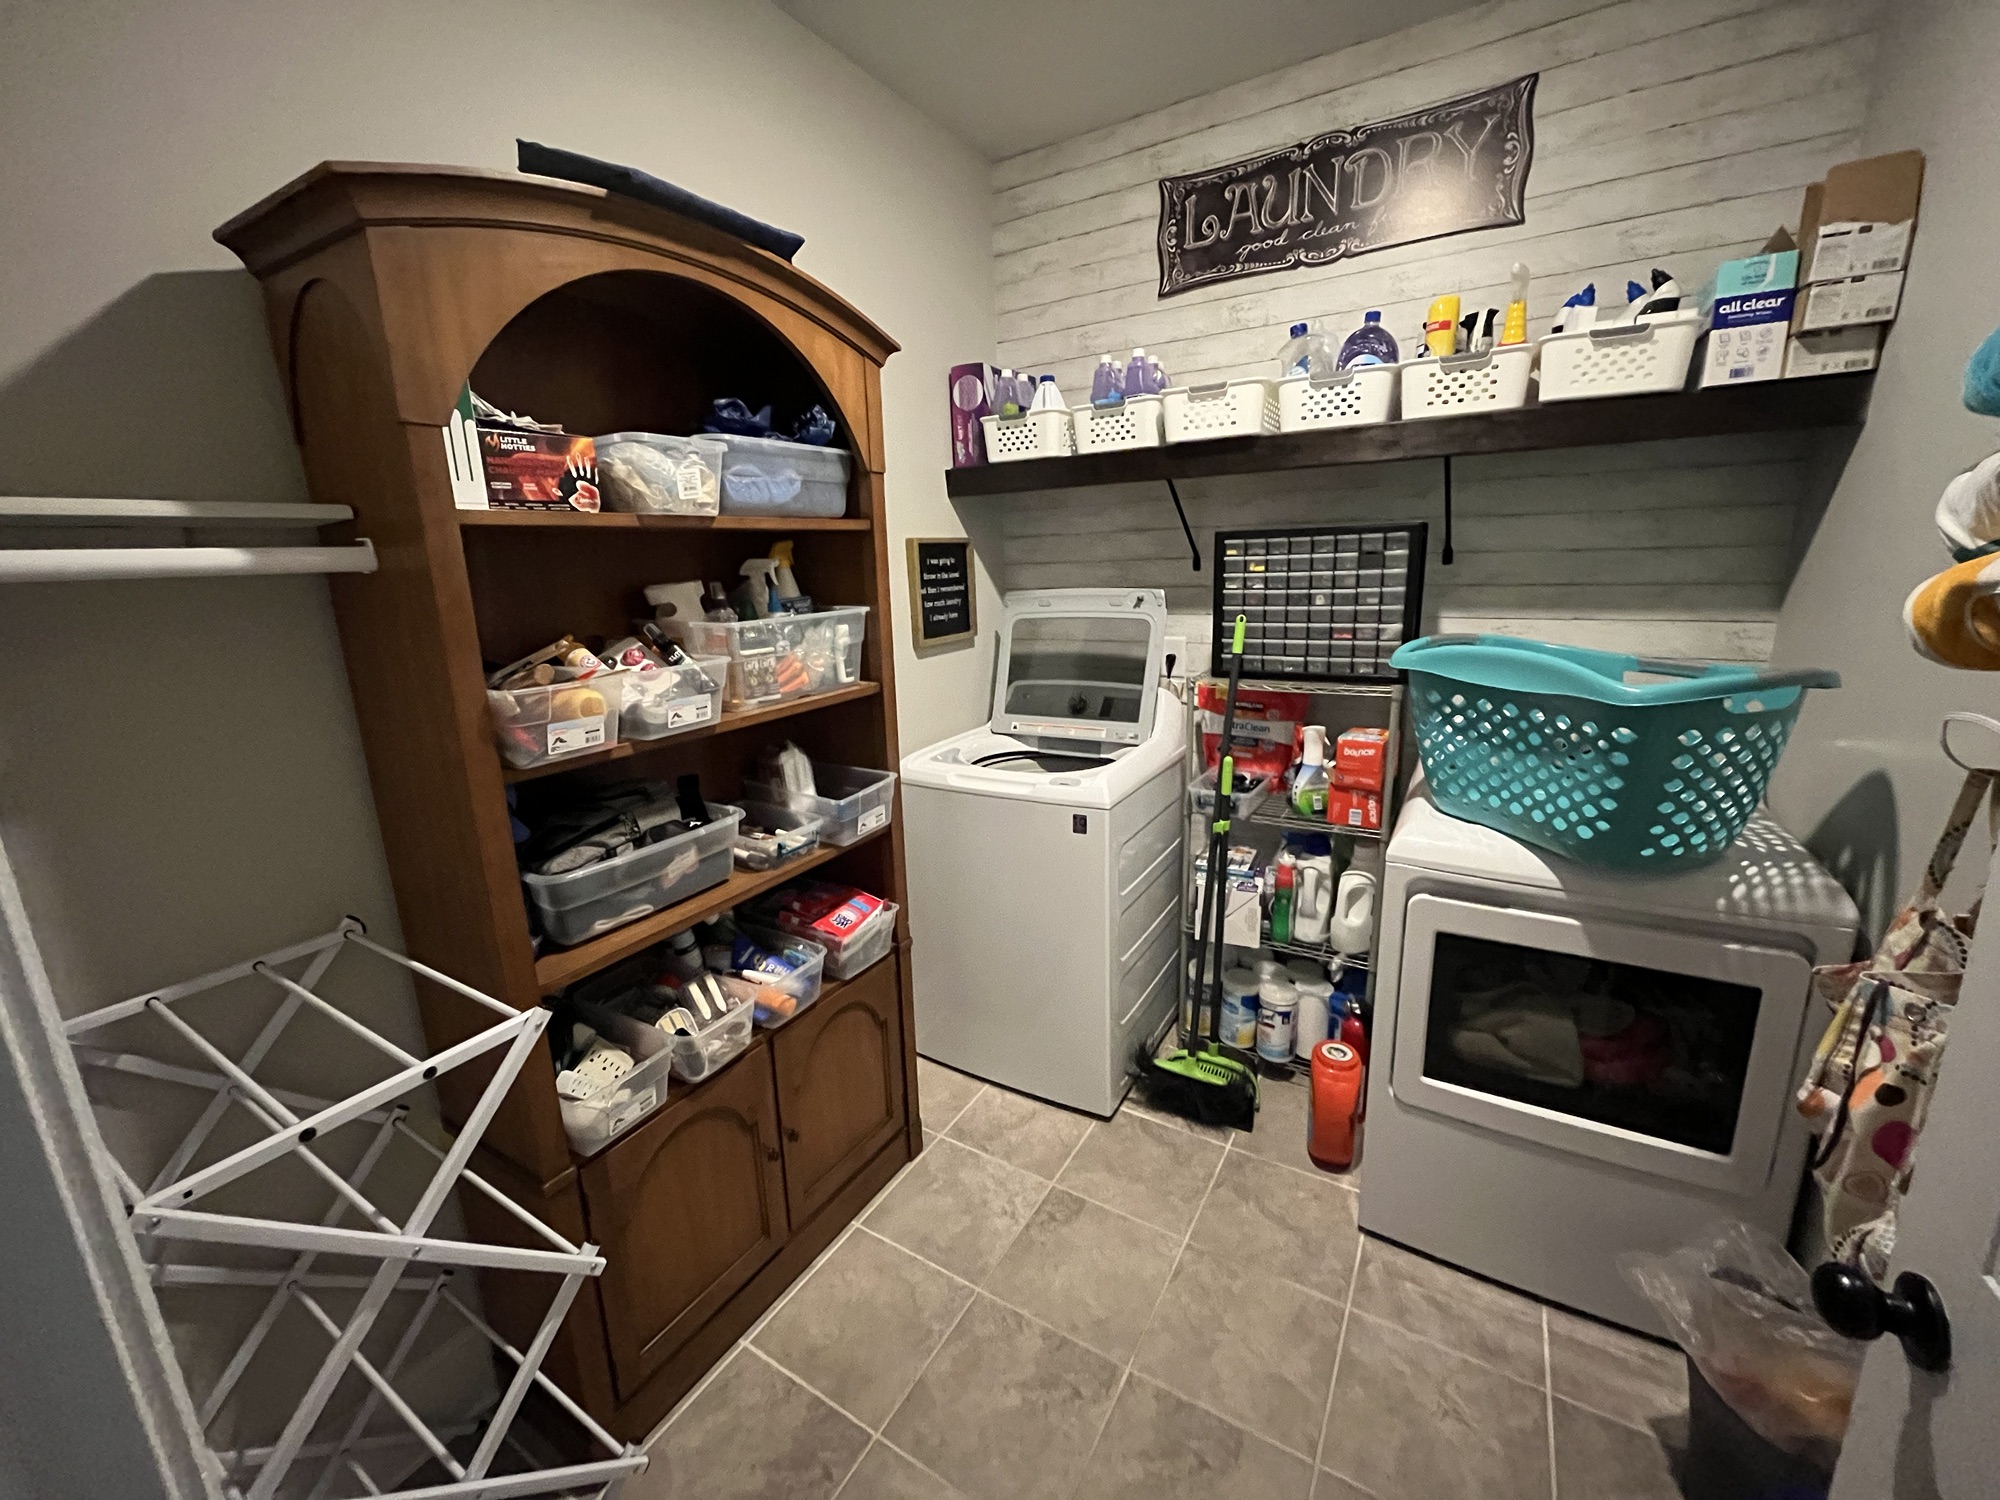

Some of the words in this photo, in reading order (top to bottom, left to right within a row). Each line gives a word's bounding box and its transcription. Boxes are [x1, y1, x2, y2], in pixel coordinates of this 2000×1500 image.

[1183, 113, 1501, 250] LAUNDRY
[1235, 232, 1290, 261] good
[1297, 215, 1359, 241] clean
[1718, 300, 1742, 314] all
[1742, 296, 1787, 311] clear
[500, 436, 527, 445] LITTLE
[500, 443, 536, 452] HOTTIES
[1343, 747, 1376, 757] bounce
